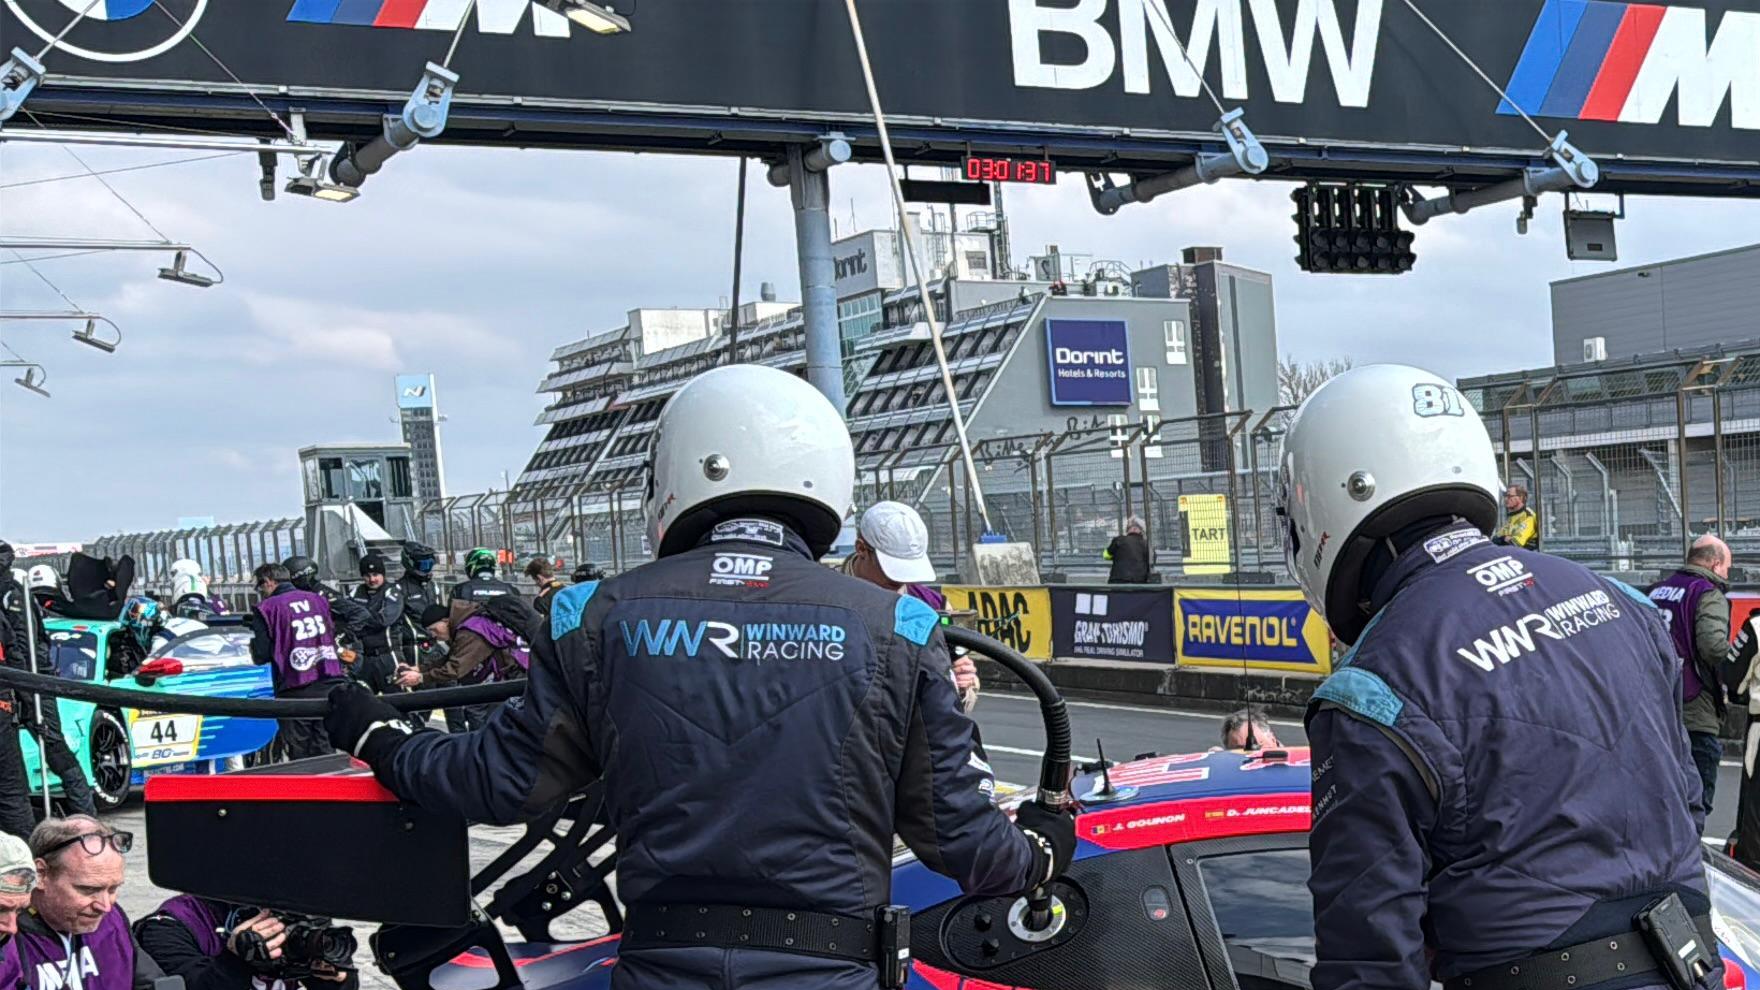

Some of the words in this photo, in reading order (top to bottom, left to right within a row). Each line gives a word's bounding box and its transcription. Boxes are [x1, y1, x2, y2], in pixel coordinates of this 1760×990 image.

[1008, 0, 1382, 108] BMW
[1056, 347, 1125, 365] Dorint
[1058, 368, 1085, 378] Hotels
[1086, 369, 1093, 377] &
[1094, 368, 1126, 379] Resorts
[1412, 383, 1465, 418] 81
[712, 556, 773, 575] OMP
[1475, 559, 1524, 587] OMP
[289, 600, 310, 613] TV
[1546, 589, 1610, 622] WINWARD
[1188, 613, 1298, 647] RAVENOL
[1561, 603, 1621, 637] RACING
[746, 623, 845, 642] WINWARD
[748, 641, 844, 661] RACING
[151, 720, 177, 743] 44
[1127, 813, 1185, 830] GOUNON
